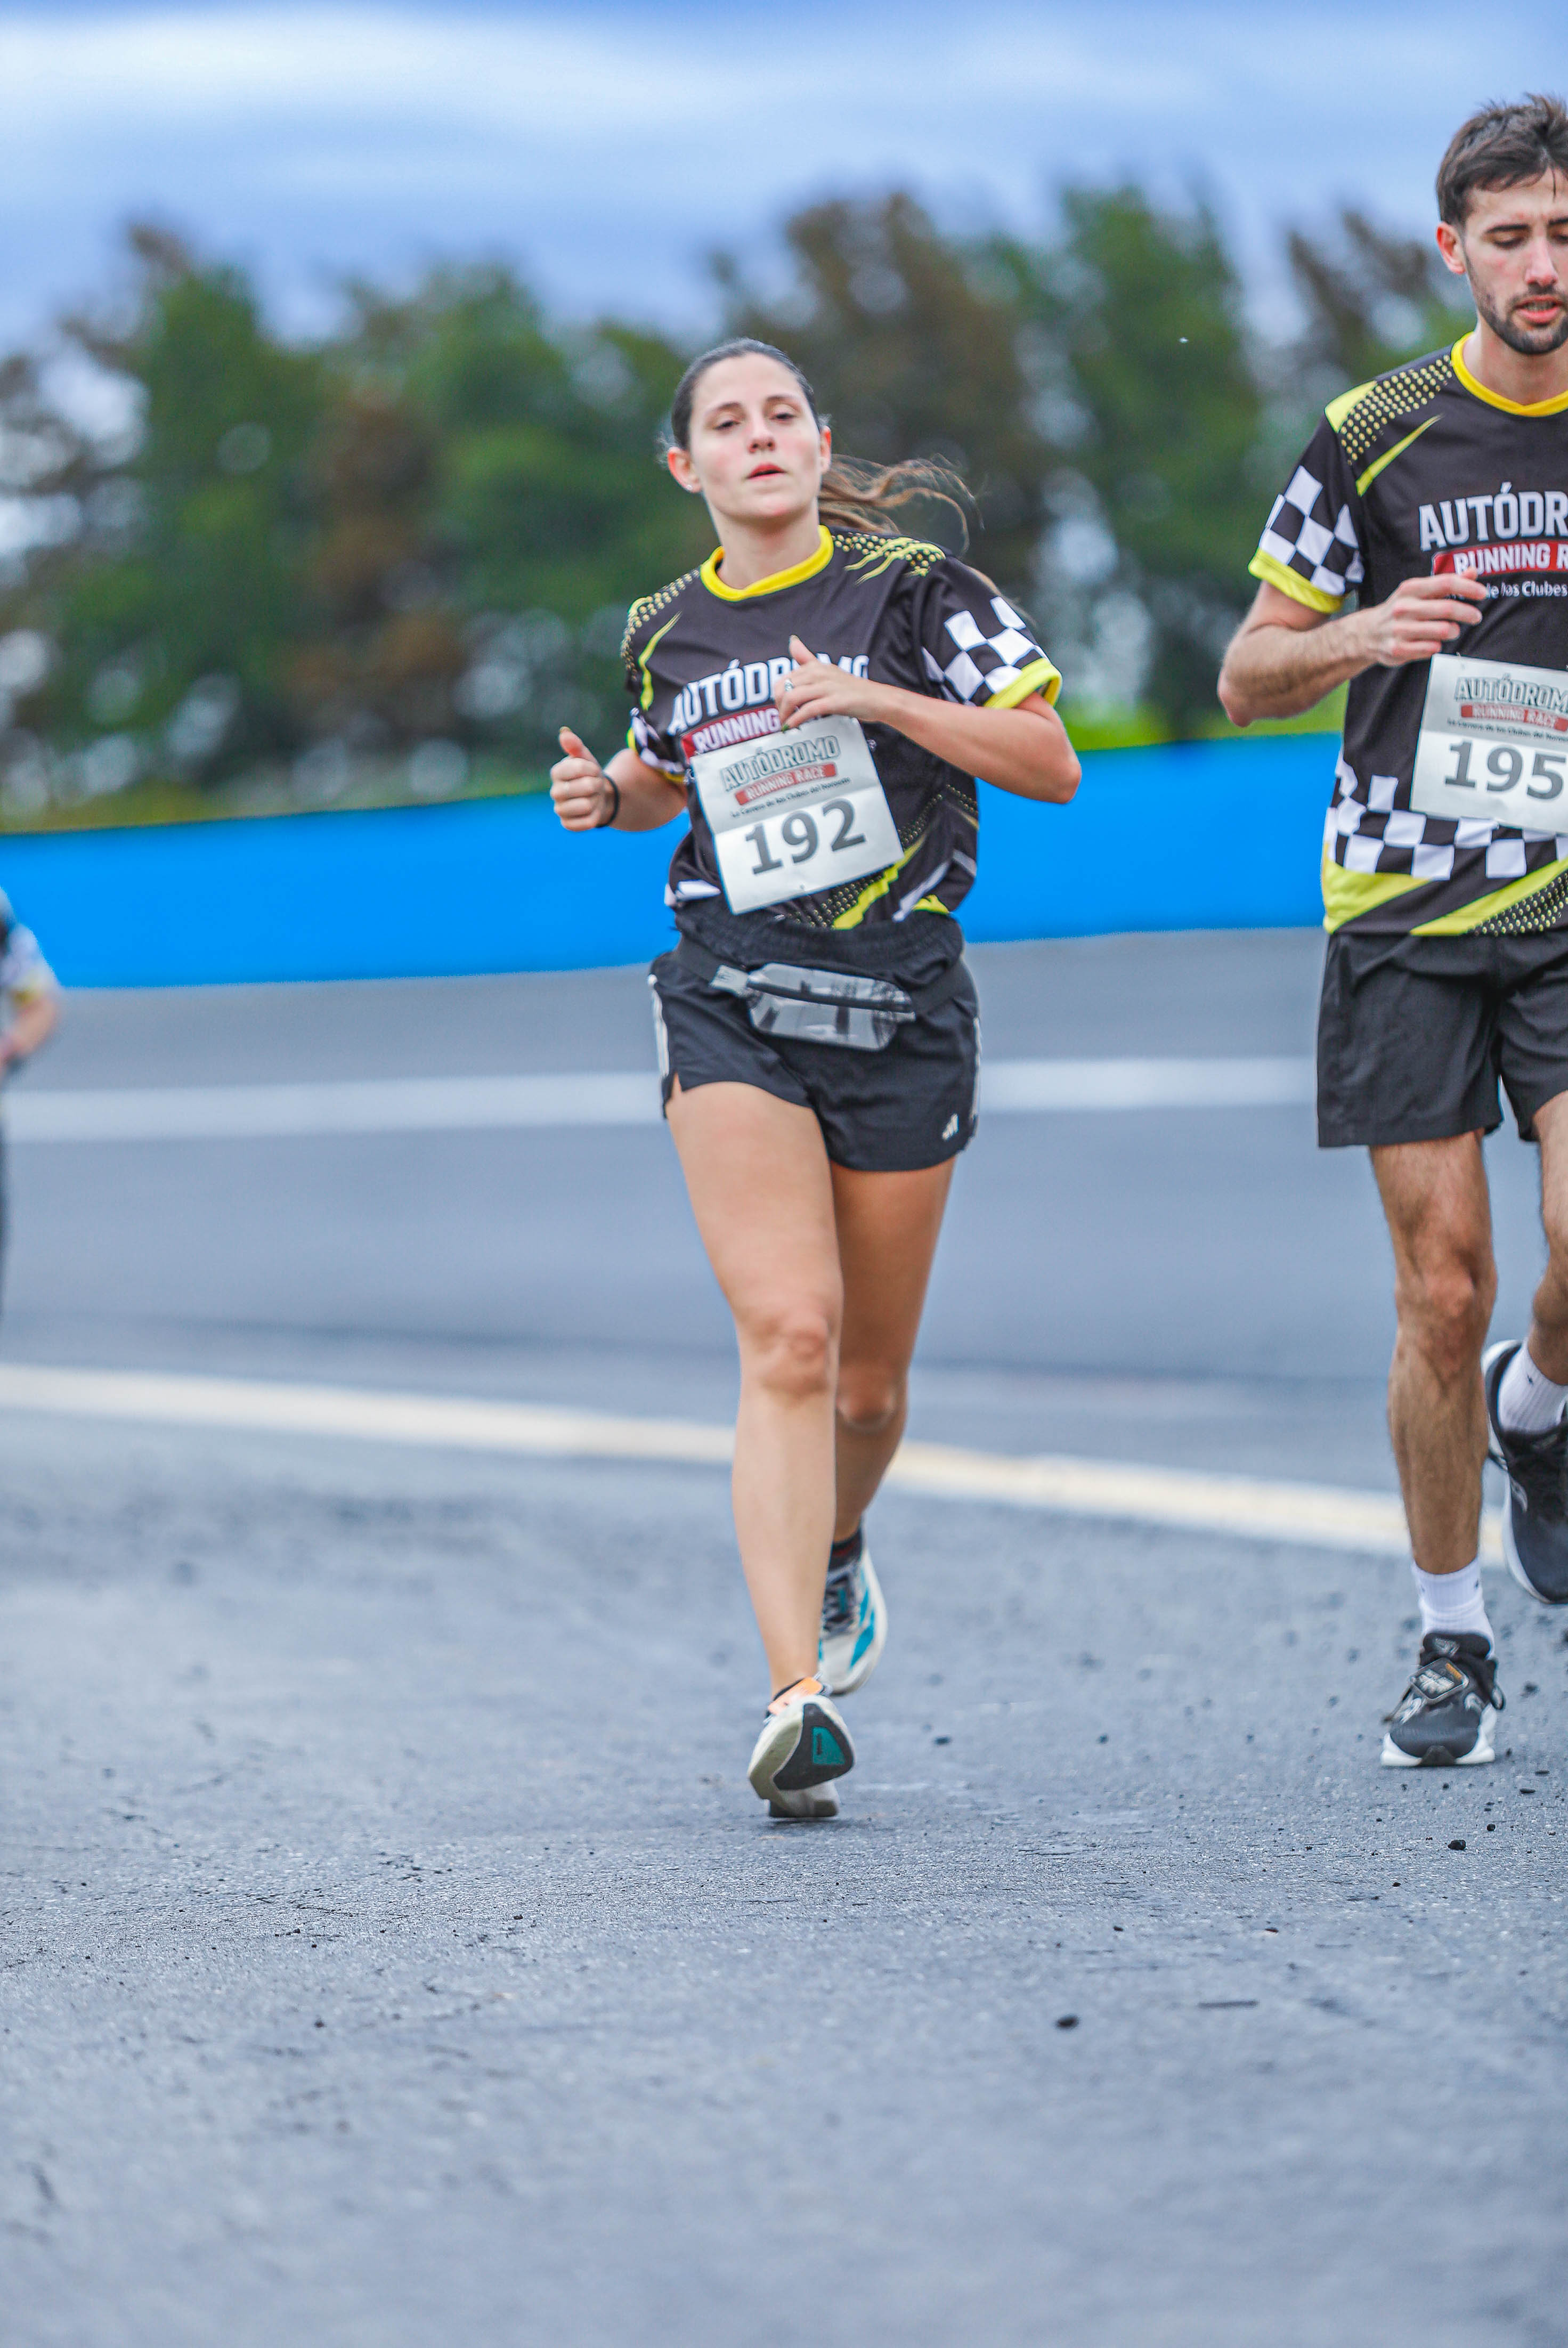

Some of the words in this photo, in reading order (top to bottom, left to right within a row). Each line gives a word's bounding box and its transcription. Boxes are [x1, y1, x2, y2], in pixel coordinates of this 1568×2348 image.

[1419, 482, 1568, 552] AUTÓDR
[1453, 542, 1551, 576] RUNNING
[1501, 582, 1520, 597] los
[1522, 581, 1568, 597] Clubes
[692, 707, 781, 753] RUNNING
[1472, 704, 1524, 720] RUNNING
[720, 735, 841, 792] AUTÓDROMO
[746, 773, 793, 800] RUNNING
[794, 767, 825, 784] RACE
[1445, 741, 1566, 800] 195
[745, 797, 867, 875] 192
